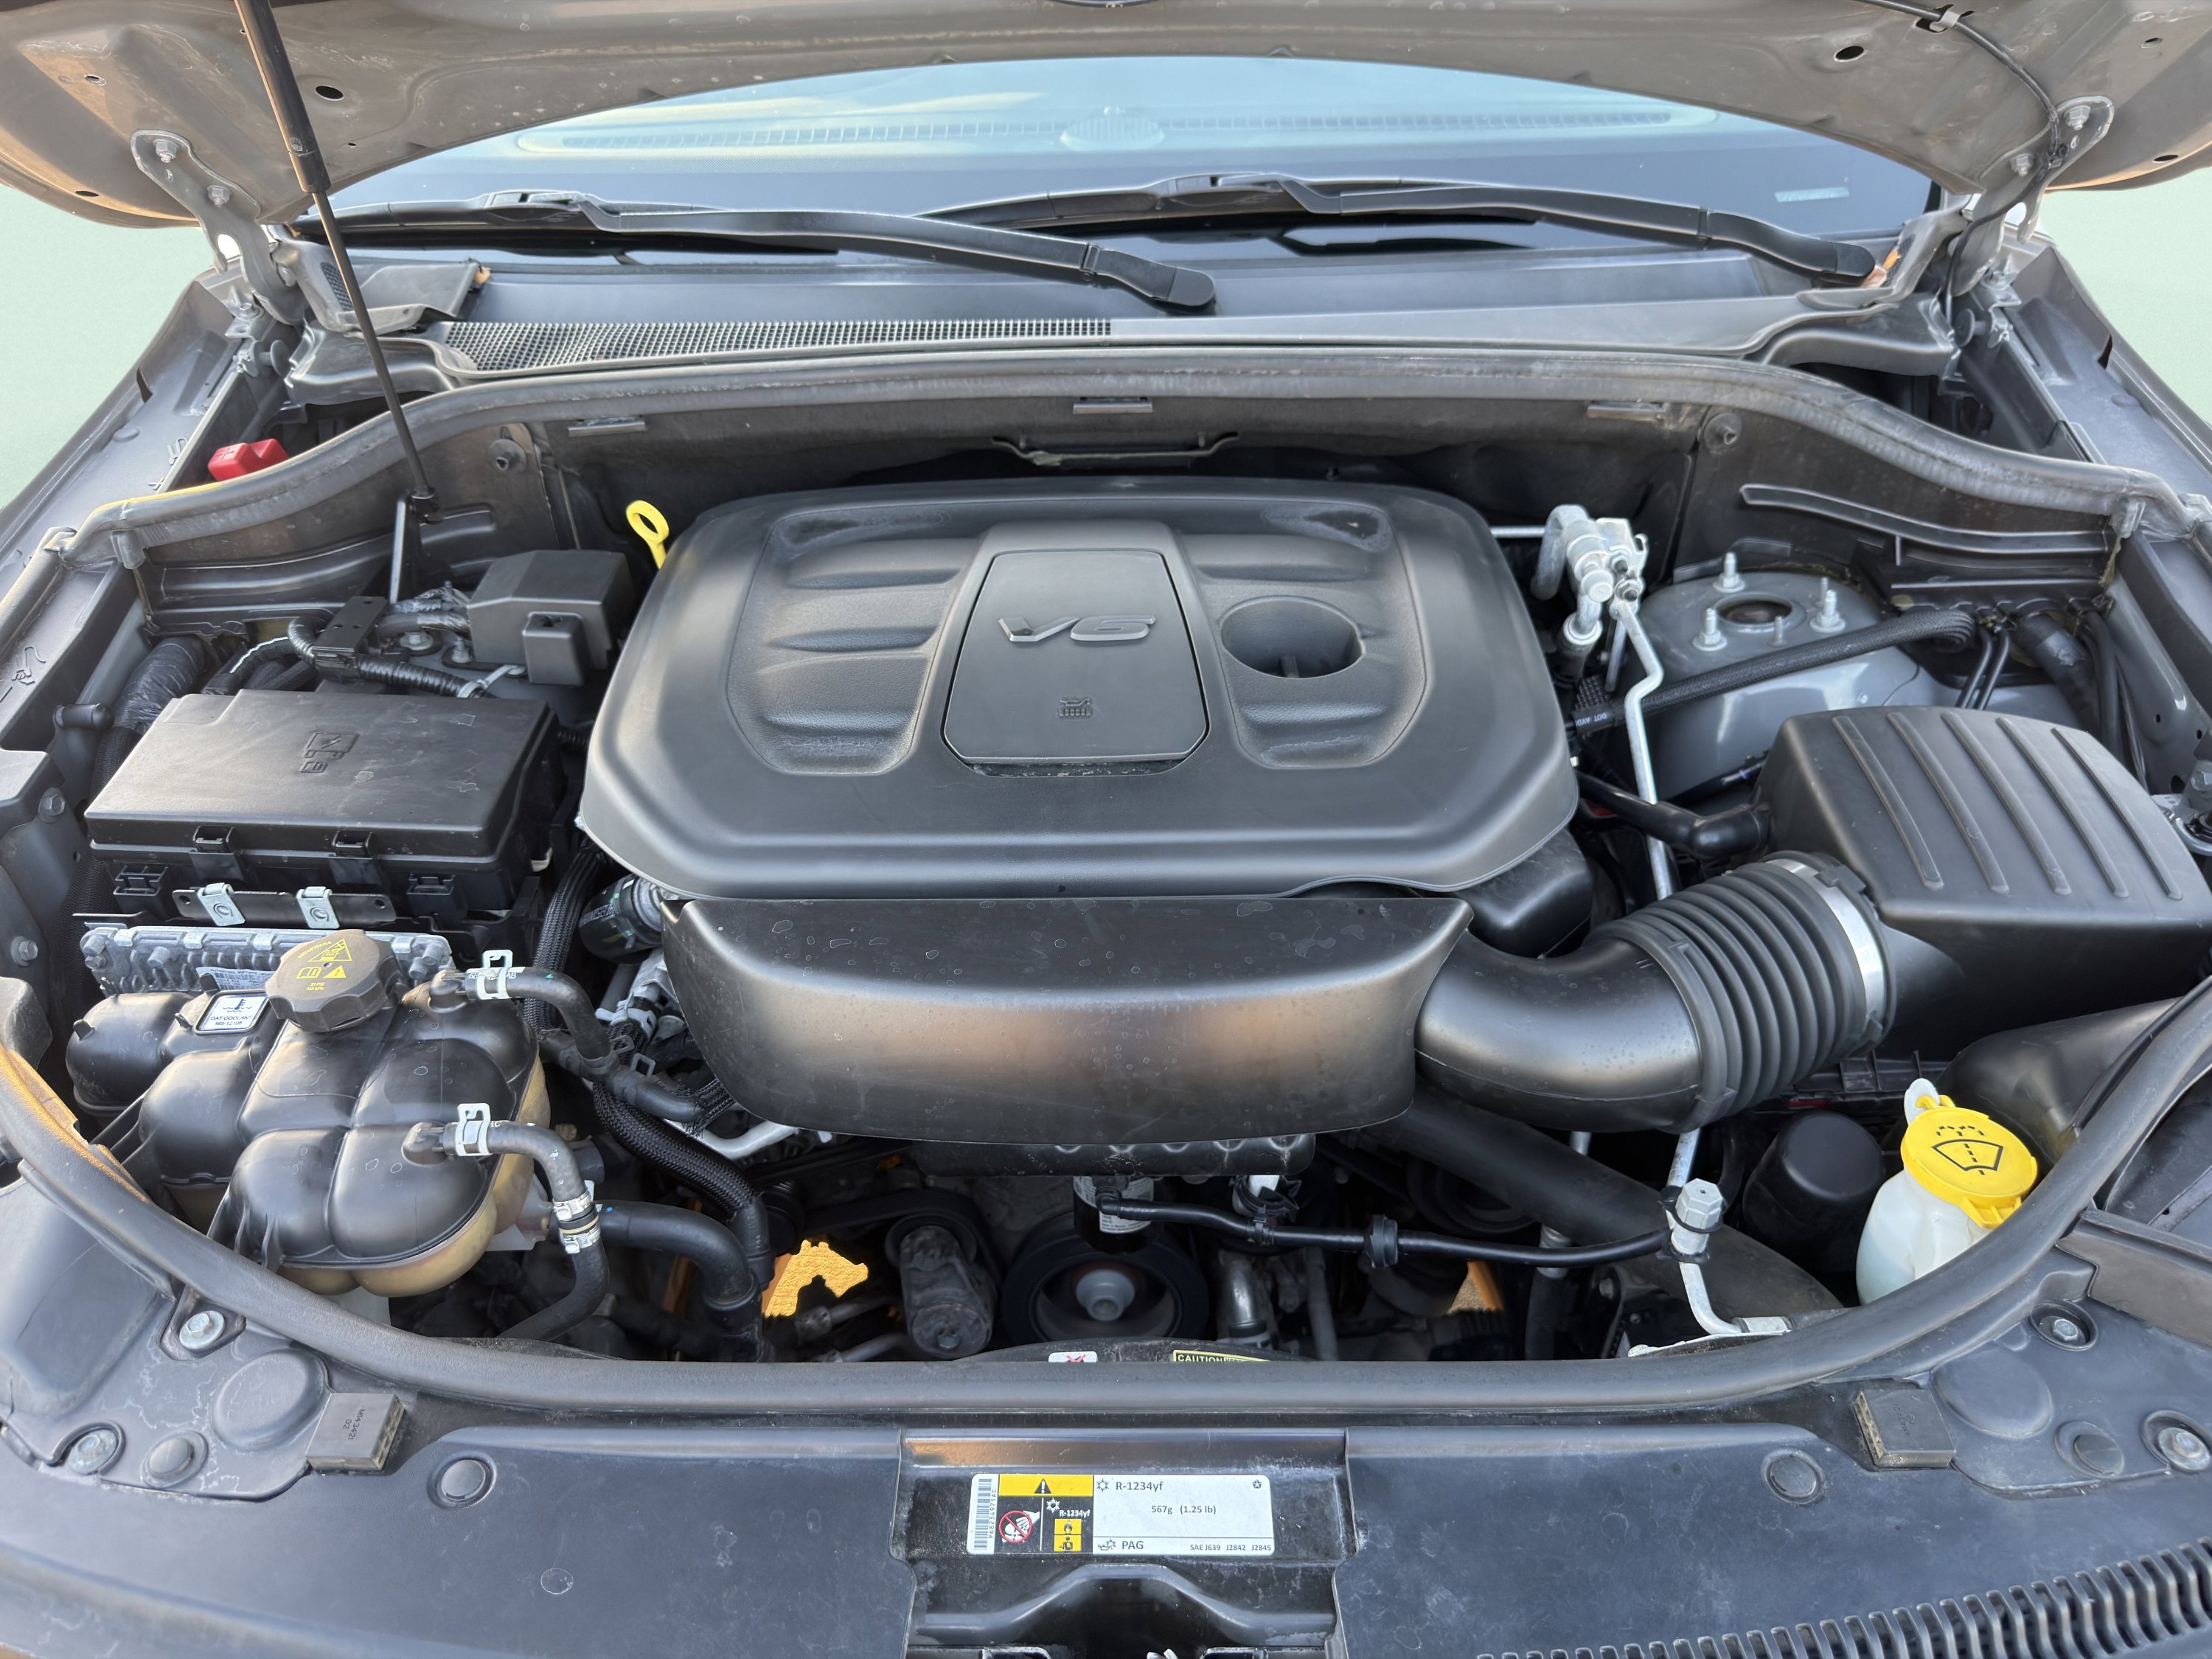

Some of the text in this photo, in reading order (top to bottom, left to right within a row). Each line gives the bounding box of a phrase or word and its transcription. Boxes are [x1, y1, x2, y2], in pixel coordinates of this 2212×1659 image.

[998, 614, 1157, 642] V6
[1593, 712, 1607, 723] DOT
[1178, 1354, 1223, 1362] CAUTION
[1116, 1481, 1164, 1492] R-1234yf
[989, 1489, 997, 1539] P68234971AC
[1060, 1509, 1091, 1518] R-1234yf
[1151, 1505, 1217, 1514] 567g (1.25 lb)
[1121, 1541, 1144, 1550] PAG
